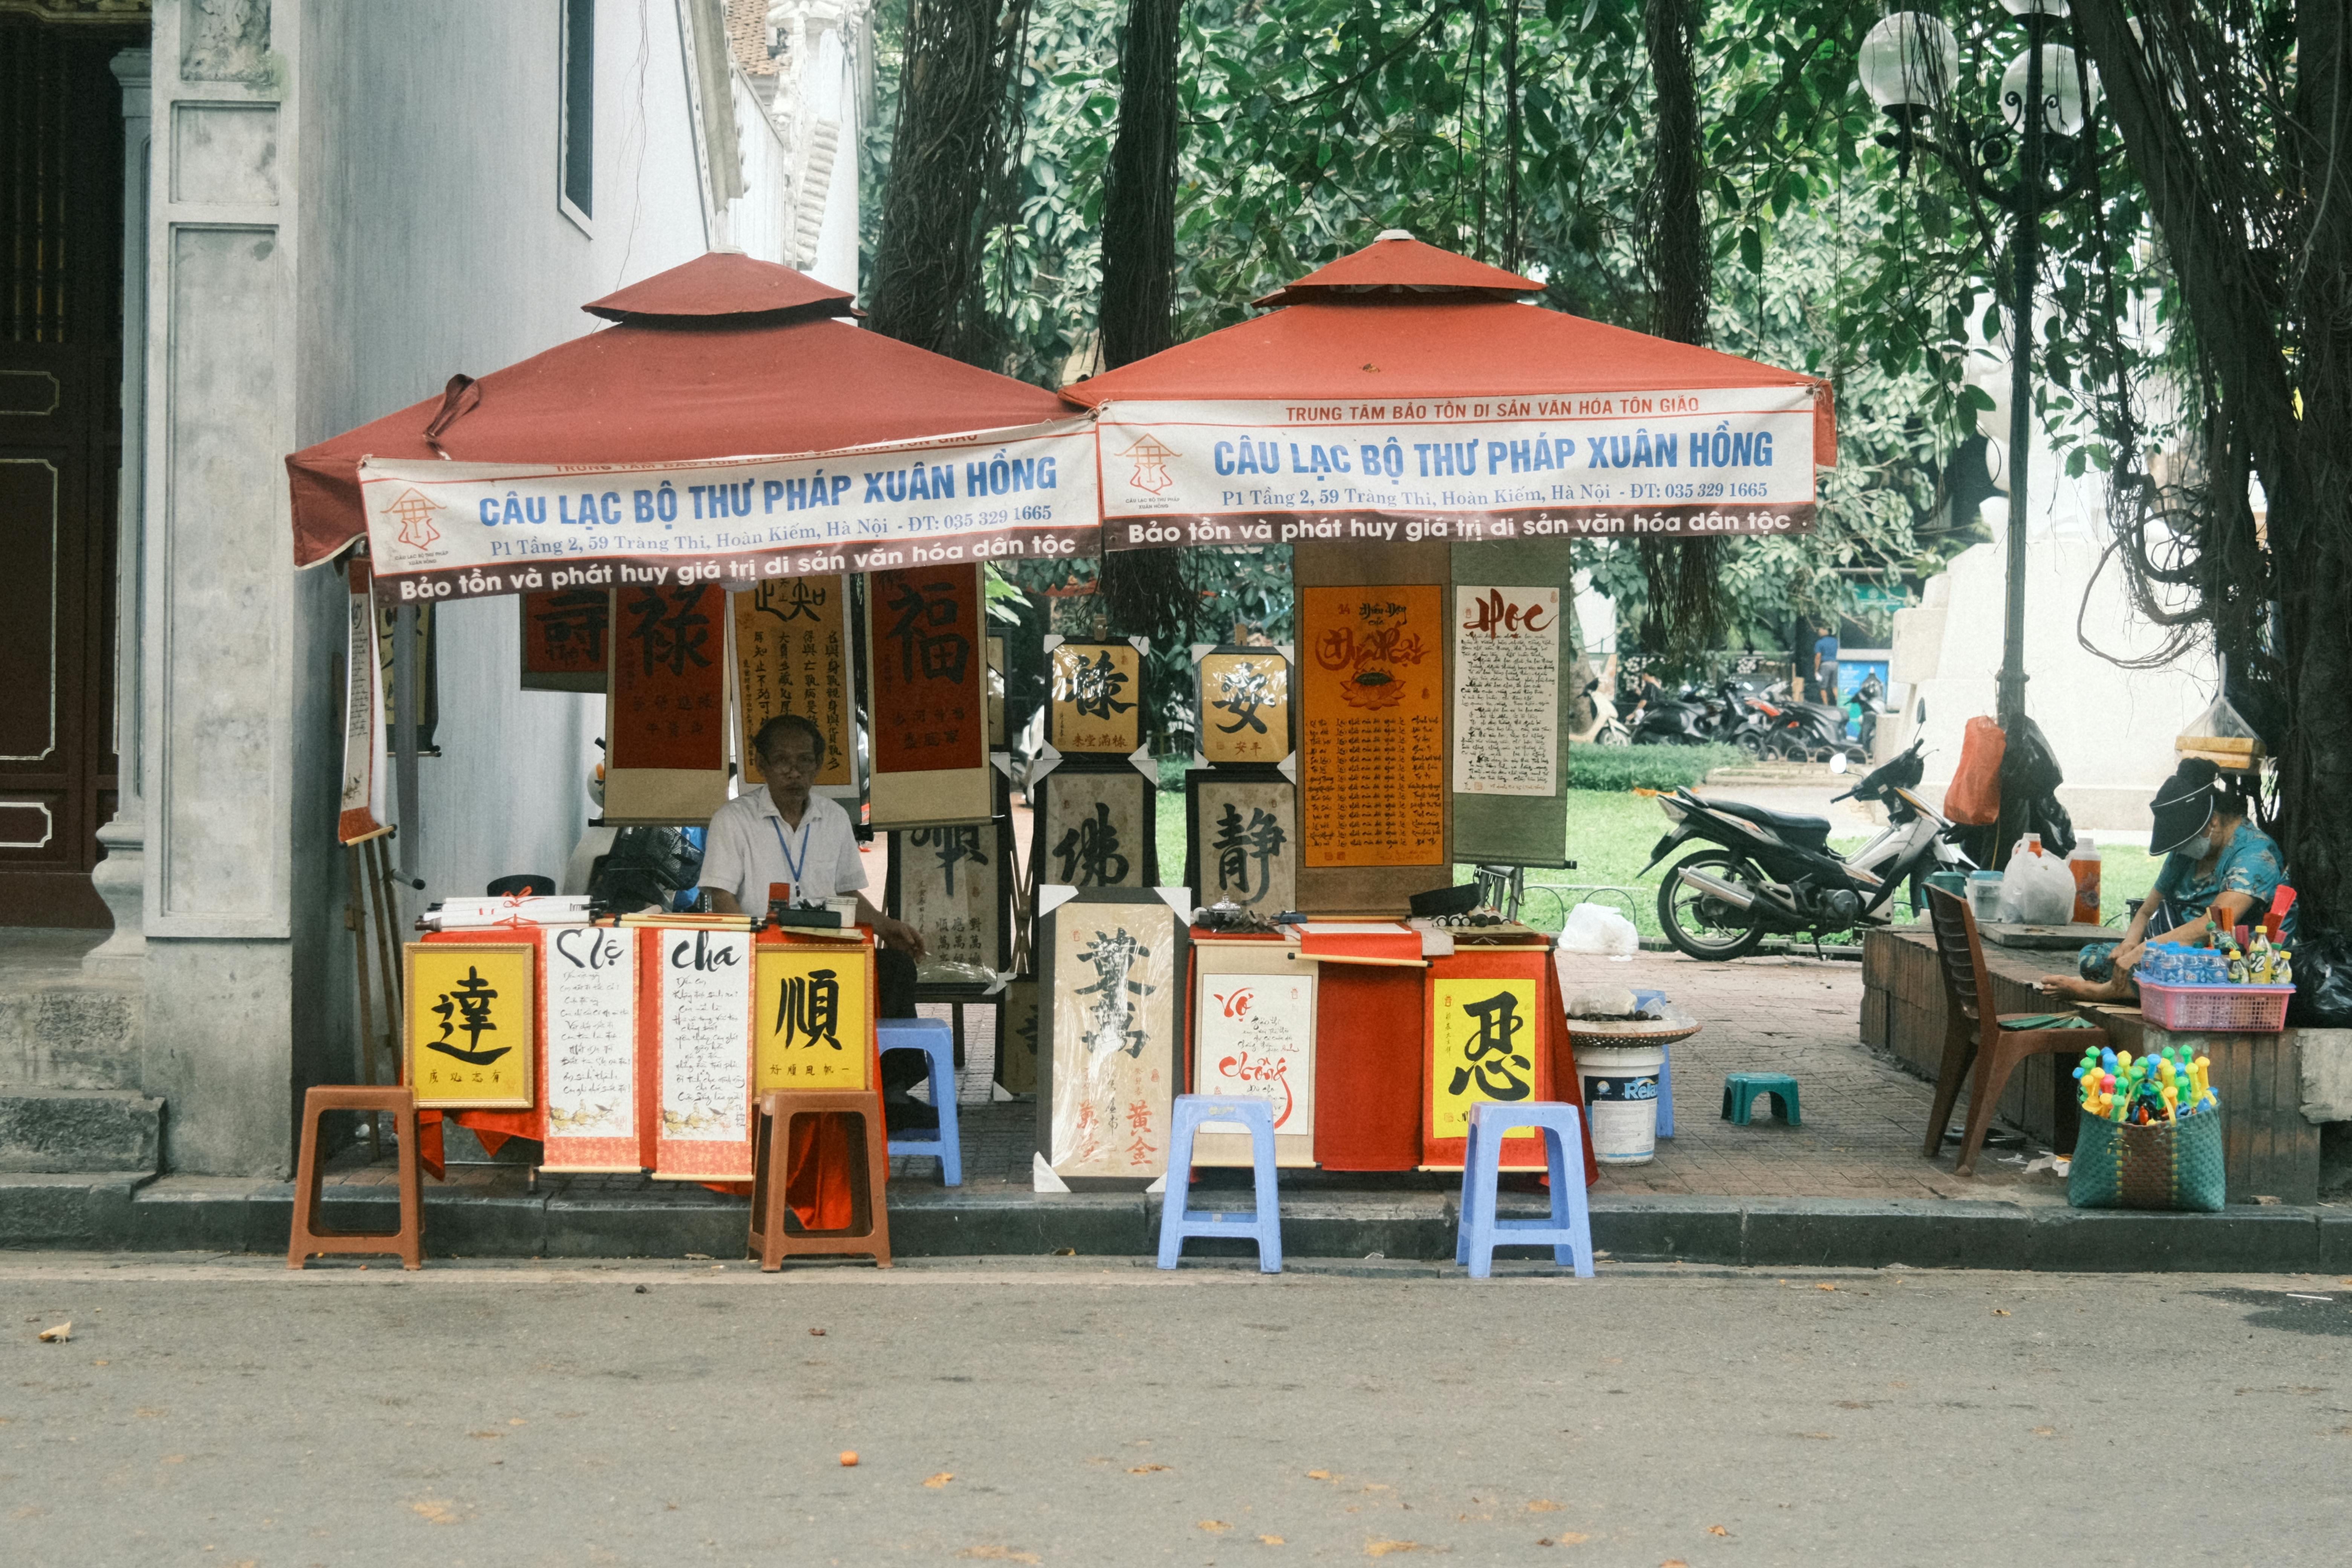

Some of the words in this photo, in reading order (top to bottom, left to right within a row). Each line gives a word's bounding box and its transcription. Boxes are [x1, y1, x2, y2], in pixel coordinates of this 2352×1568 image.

[1286, 406, 1342, 421] TRUNG
[1349, 403, 1385, 420] TÂM
[1393, 402, 1426, 420] BẢO
[1434, 400, 1465, 418] TỒN
[1475, 403, 1490, 418] DI
[1498, 399, 1530, 416] SẢN
[1538, 398, 1571, 415] VĂN
[1579, 397, 1612, 414] HÓA
[1620, 396, 1652, 413] TÔN
[1660, 397, 1698, 411] GIÁO
[1214, 435, 1280, 476] CÂU
[1290, 443, 1351, 481] LẠC
[1360, 437, 1403, 484] BỘ
[1413, 439, 1478, 476] THƯ
[1488, 432, 1576, 475] PHÁP
[1587, 429, 1677, 469] XUÂN
[1689, 420, 1772, 467] HỒNG
[479, 491, 547, 527] CÂU
[559, 487, 622, 530] LẠC
[634, 480, 677, 530] BỘ
[688, 478, 754, 519] THƯ
[764, 469, 851, 514] PHÁP
[863, 461, 955, 504] XUÂN
[967, 448, 1056, 498] HỒNG
[1222, 491, 1243, 505] P1
[1249, 486, 1295, 507] Tầng
[1300, 490, 1314, 506] 2,
[1319, 490, 1339, 504] 59
[1344, 488, 1397, 507] Tràng
[1401, 491, 1436, 507] Thi,
[1441, 489, 1487, 505] Hoàn
[1494, 484, 1545, 503] Kiếm,
[1551, 484, 1573, 500] Hà
[1580, 483, 1610, 500] Nội
[1630, 483, 1660, 499] ĐT:
[1665, 484, 1692, 498] 035
[1697, 483, 1724, 498] 329
[1729, 482, 1767, 497] 1665
[492, 541, 510, 556] P1
[518, 535, 563, 556] Tầng
[568, 537, 583, 553] 2,
[589, 536, 608, 550] 59
[614, 534, 669, 553] Tràng
[674, 534, 711, 552] Thi,
[717, 529, 763, 549] Hoàn
[769, 524, 821, 543] Kiếm,
[827, 519, 851, 536] Hà
[857, 517, 888, 537] Nội
[908, 515, 940, 532] ĐT:
[944, 513, 974, 530] 035
[978, 510, 1008, 526] 329
[1014, 505, 1052, 521] 1665
[1129, 519, 1180, 543] Bảo
[1189, 516, 1231, 541] tồn
[1239, 518, 1271, 539] và
[1282, 516, 1340, 543] phát
[1351, 518, 1397, 540] huy
[1406, 516, 1447, 542] giá
[1456, 518, 1482, 541] trị
[1490, 517, 1514, 536] di
[1523, 513, 1568, 534] sản
[1577, 513, 1624, 533] văn
[1634, 513, 1680, 532] hóa
[1689, 512, 1738, 531] dân
[1747, 510, 1790, 534] tộc
[400, 576, 451, 600] Bảo
[459, 568, 502, 593] tồn
[510, 566, 542, 589] và
[552, 562, 615, 591] phát
[621, 563, 669, 586] huy
[677, 559, 721, 585] giá
[729, 559, 756, 581] trị
[764, 556, 790, 574] di
[798, 549, 845, 572] sản
[854, 547, 903, 568] văn
[913, 542, 963, 561] hóa
[972, 536, 1024, 557] dân
[1032, 534, 1076, 558] tộc
[887, 582, 970, 684] 福
[1052, 802, 1130, 887] 佛
[426, 966, 512, 1065] 達
[775, 969, 842, 1050] 順
[1624, 1083, 1658, 1099] Rela
